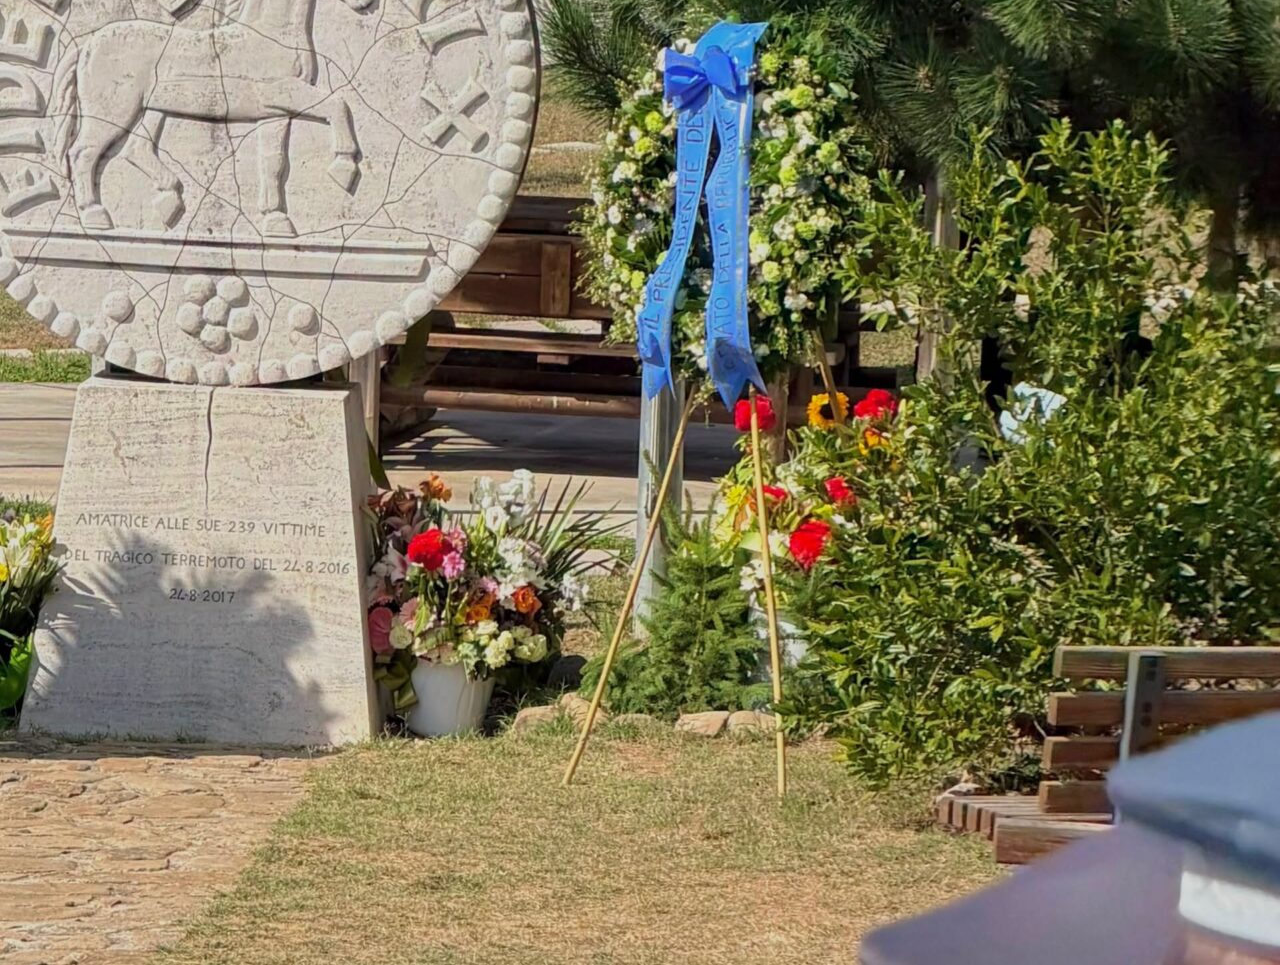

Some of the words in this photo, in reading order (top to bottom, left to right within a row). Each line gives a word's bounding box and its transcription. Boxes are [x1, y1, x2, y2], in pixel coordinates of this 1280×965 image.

[643, 312, 660, 331] IL
[652, 159, 700, 302] PRESIDENTE
[684, 112, 705, 144] DE
[76, 512, 149, 528] AMATRICE
[155, 516, 190, 531] ALLE
[195, 518, 221, 532] SUE
[227, 520, 256, 534] 239
[263, 522, 326, 537] VITTIME
[64, 548, 90, 561] DEL
[96, 549, 154, 565] TRAGICO
[161, 552, 246, 570] TERREMOTO
[253, 557, 277, 571] DEL
